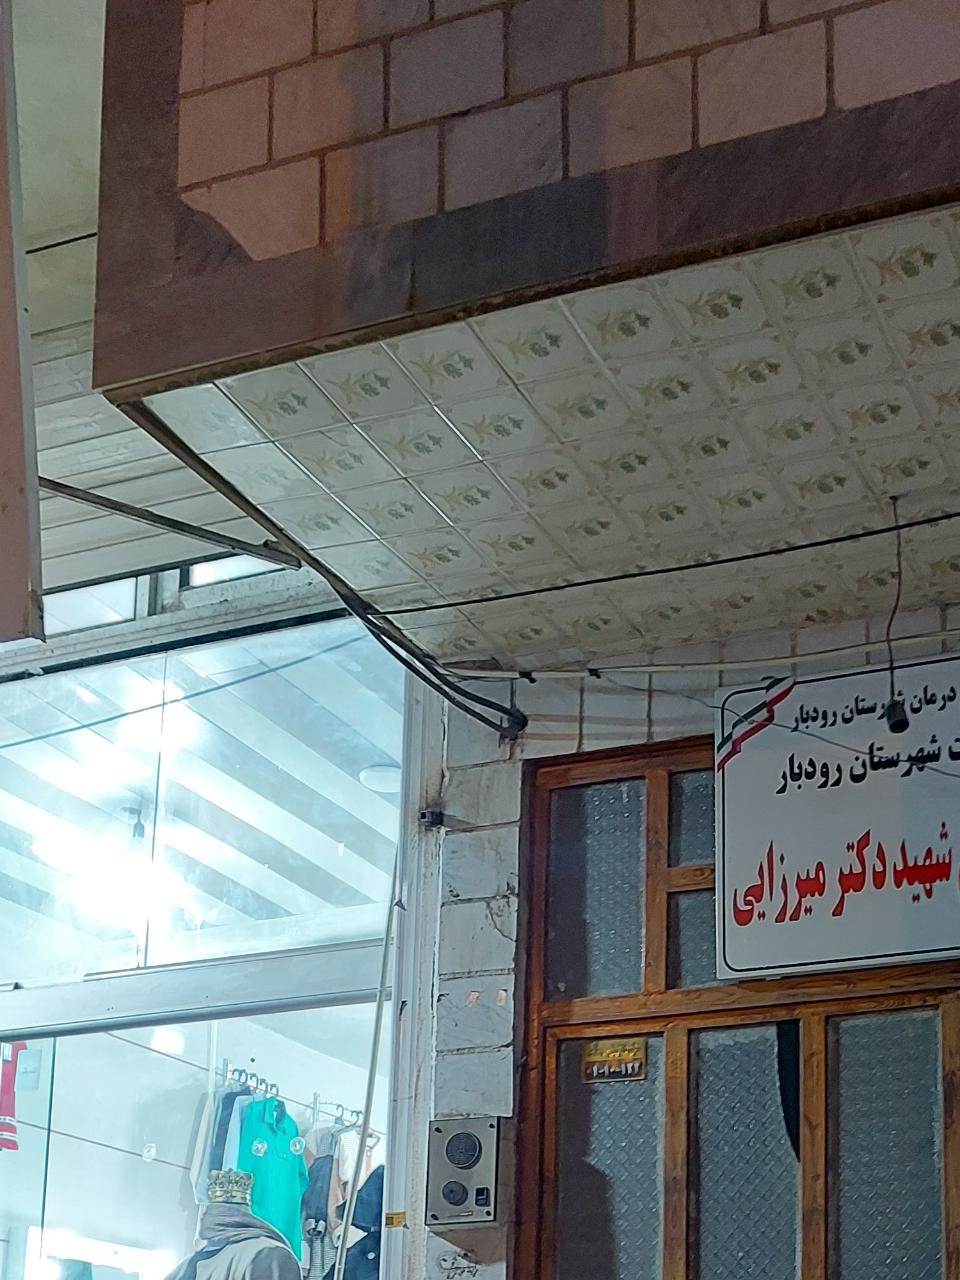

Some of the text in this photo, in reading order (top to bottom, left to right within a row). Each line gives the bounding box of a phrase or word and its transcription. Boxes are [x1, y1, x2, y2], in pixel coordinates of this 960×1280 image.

[790, 704, 838, 733] رودبار
[841, 689, 906, 725] شرستان
[910, 685, 958, 715] درمان
[775, 752, 843, 795] رودبار
[849, 734, 942, 784] شهرستان
[732, 840, 827, 928] میرزایی
[831, 828, 887, 918] دکتر
[892, 821, 953, 904] شهید
